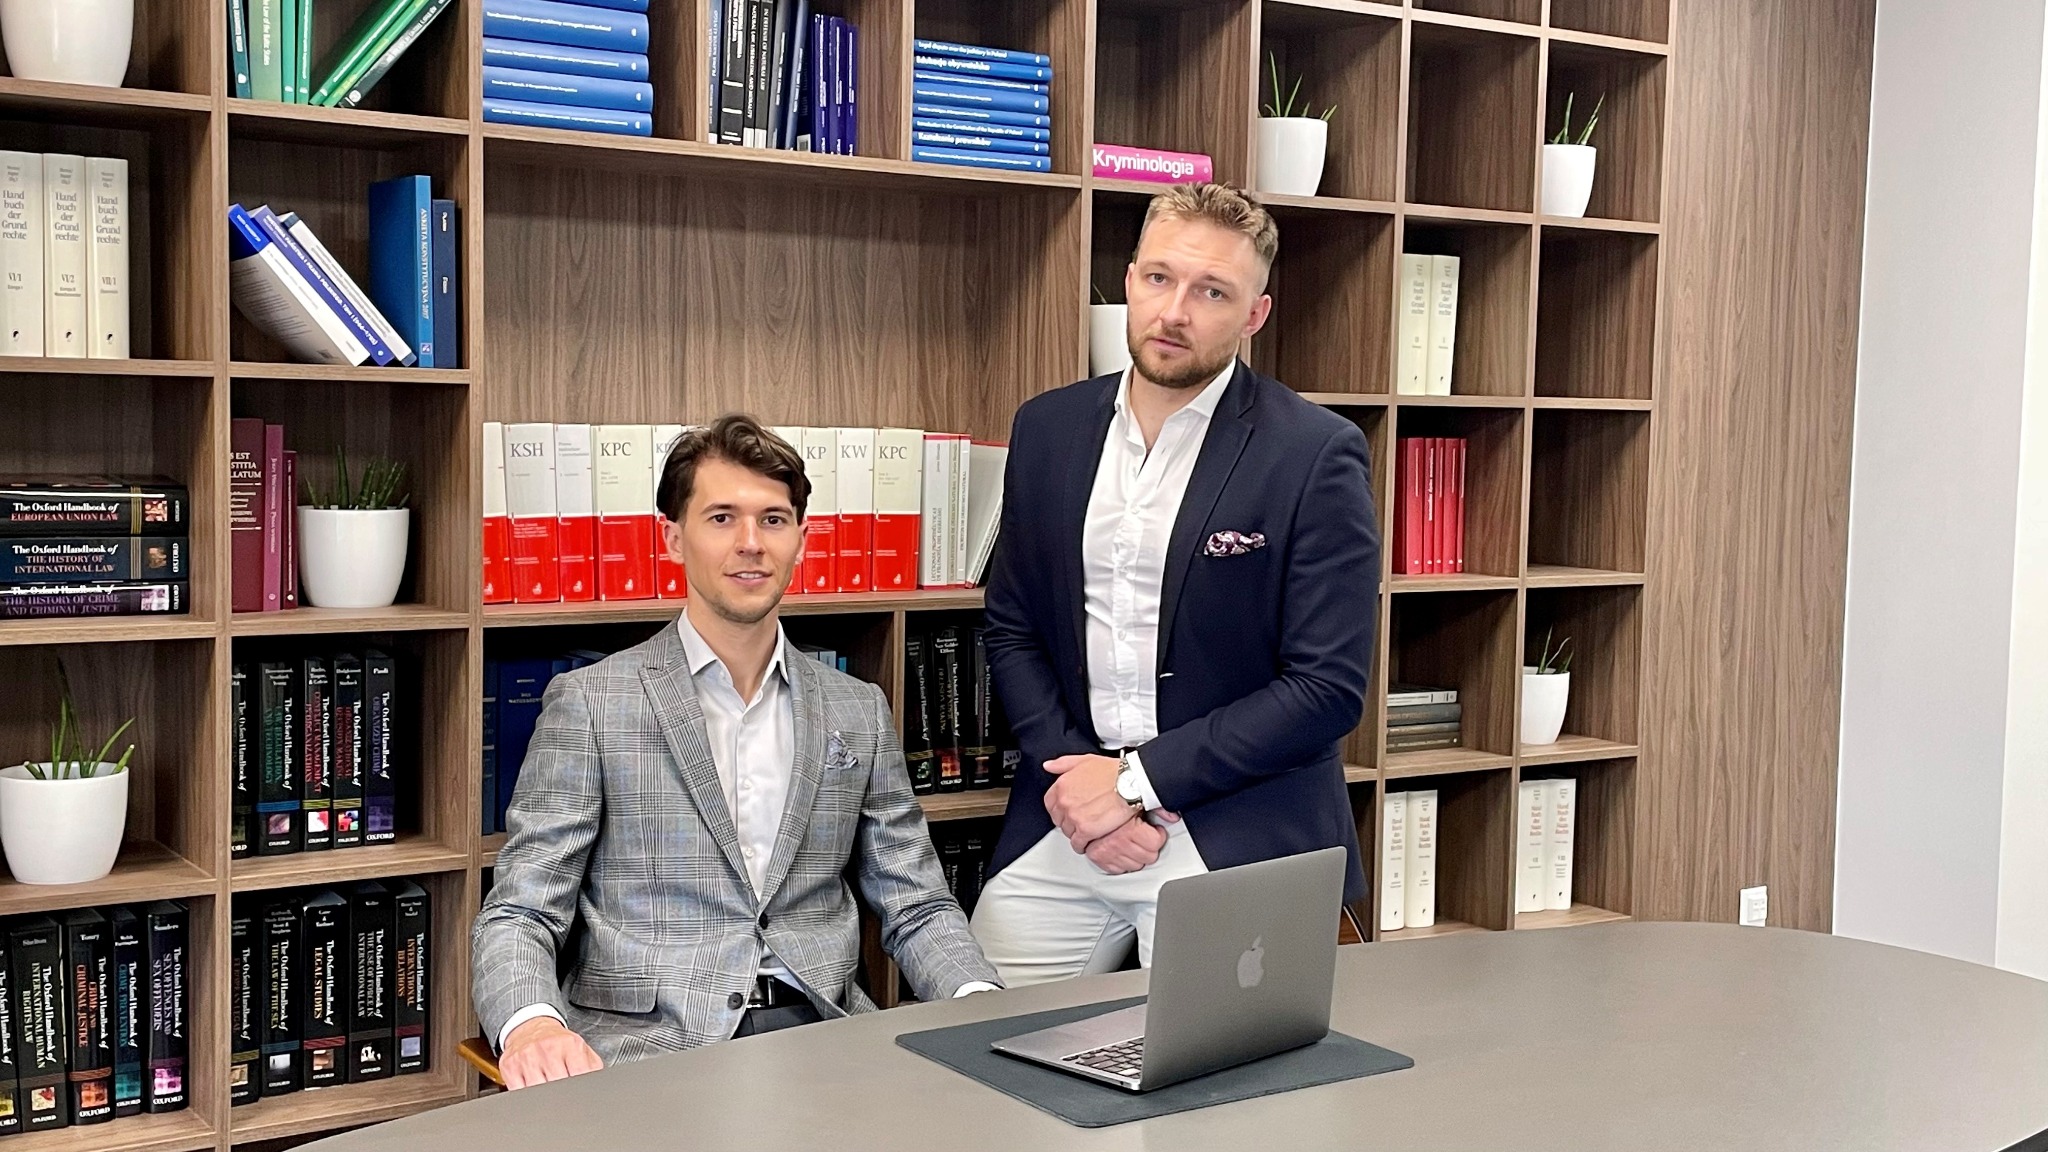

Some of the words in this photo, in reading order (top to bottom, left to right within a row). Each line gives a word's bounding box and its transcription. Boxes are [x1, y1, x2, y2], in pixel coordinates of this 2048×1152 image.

[1092, 149, 1194, 178] Kryminologia
[2, 190, 24, 200] Hand
[56, 192, 77, 202] Hand
[97, 195, 118, 205] Hand
[4, 200, 24, 210] buch
[56, 202, 76, 212] buch
[98, 206, 117, 215] buch
[7, 210, 21, 220] der
[61, 213, 73, 222] der
[102, 216, 114, 224] der
[2, 221, 27, 229] Grund
[54, 223, 79, 232] Grund
[96, 226, 120, 235] Grund
[420, 208, 428, 240] ANKIETA
[2, 232, 26, 240] rechte
[56, 233, 79, 242] rechte
[96, 236, 120, 244] rechte
[420, 241, 429, 303] KONSTYTUCYJNA
[236, 452, 250, 460] EST
[511, 442, 544, 457] KSH
[600, 442, 632, 456] KPC
[806, 446, 826, 459] KP
[840, 445, 868, 458] KW
[879, 446, 907, 459] KPC
[13, 502, 30, 511] The
[32, 502, 62, 512] Oxford
[64, 502, 106, 511] Handbook
[108, 502, 119, 512] of
[11, 513, 64, 521] EUROPEAN
[67, 513, 97, 521] UNION
[100, 513, 118, 521] LAW
[12, 545, 30, 554] The
[31, 545, 61, 554] Oxford
[62, 545, 106, 553] Handbook
[108, 544, 118, 554] of
[48, 555, 88, 563] HISTORY
[15, 565, 94, 573] INTERNATIONAL
[96, 564, 114, 572] LAW
[5, 596, 25, 605] THE
[28, 596, 70, 604] HISTORY
[73, 595, 86, 603] OF
[89, 594, 120, 603] CRIME
[6, 607, 27, 615] AND
[30, 606, 77, 614] CRIMINAL
[81, 605, 119, 613] JUSTICE
[372, 697, 380, 745] ORGANIZED
[372, 747, 380, 774] CRIME
[380, 771, 389, 779] of
[367, 833, 394, 841] OXFORD
[375, 929, 383, 944] The
[271, 944, 279, 961] THE
[280, 940, 289, 955] The
[326, 940, 334, 954] The
[163, 953, 172, 970] SEX
[173, 947, 182, 962] The
[98, 957, 107, 972] The
[153, 959, 161, 976] SEX
[280, 956, 288, 981] Oxford
[314, 947, 322, 978] LEGAL
[326, 955, 334, 979] Oxford
[42, 966, 52, 982] The
[271, 962, 279, 978] LAW
[367, 967, 374, 978] OF
[397, 950, 405, 997] RELATIONS
[407, 939, 415, 1006] INTERNATIONAL
[118, 964, 127, 992] CRIME
[76, 964, 86, 1010] CRIMINAL
[98, 973, 106, 999] Oxford
[271, 982, 279, 992] OF
[375, 971, 383, 1008] Handbook
[31, 962, 43, 1034] INTERNATIONAL
[43, 983, 53, 1010] Oxford
[88, 982, 97, 1011] CRIME
[163, 972, 172, 1018] OFFENCES
[280, 983, 288, 1020] Handbook
[314, 980, 322, 1019] STUDIES
[326, 980, 334, 1016] Handbook
[22, 990, 32, 1023] RIGHTS
[153, 979, 162, 1030] OFFENDERS
[271, 994, 279, 1011] THE
[367, 1008, 374, 1017] IN
[374, 1009, 383, 1018] of
[99, 1001, 107, 1039] Handbook
[118, 994, 127, 1047] PREVENTION
[271, 1013, 279, 1029] SEA
[279, 1022, 289, 1031] of
[324, 1017, 334, 1026] of
[24, 1025, 33, 1044] LAW
[44, 1012, 55, 1051] Handbook
[77, 1012, 87, 1047] JUSTICE
[173, 1030, 182, 1038] of
[35, 1036, 45, 1068] HUMAN
[98, 1041, 108, 1049] of
[44, 1053, 56, 1063] of
[153, 1096, 183, 1105] OXFORD
[79, 1107, 110, 1117] OXFORD
